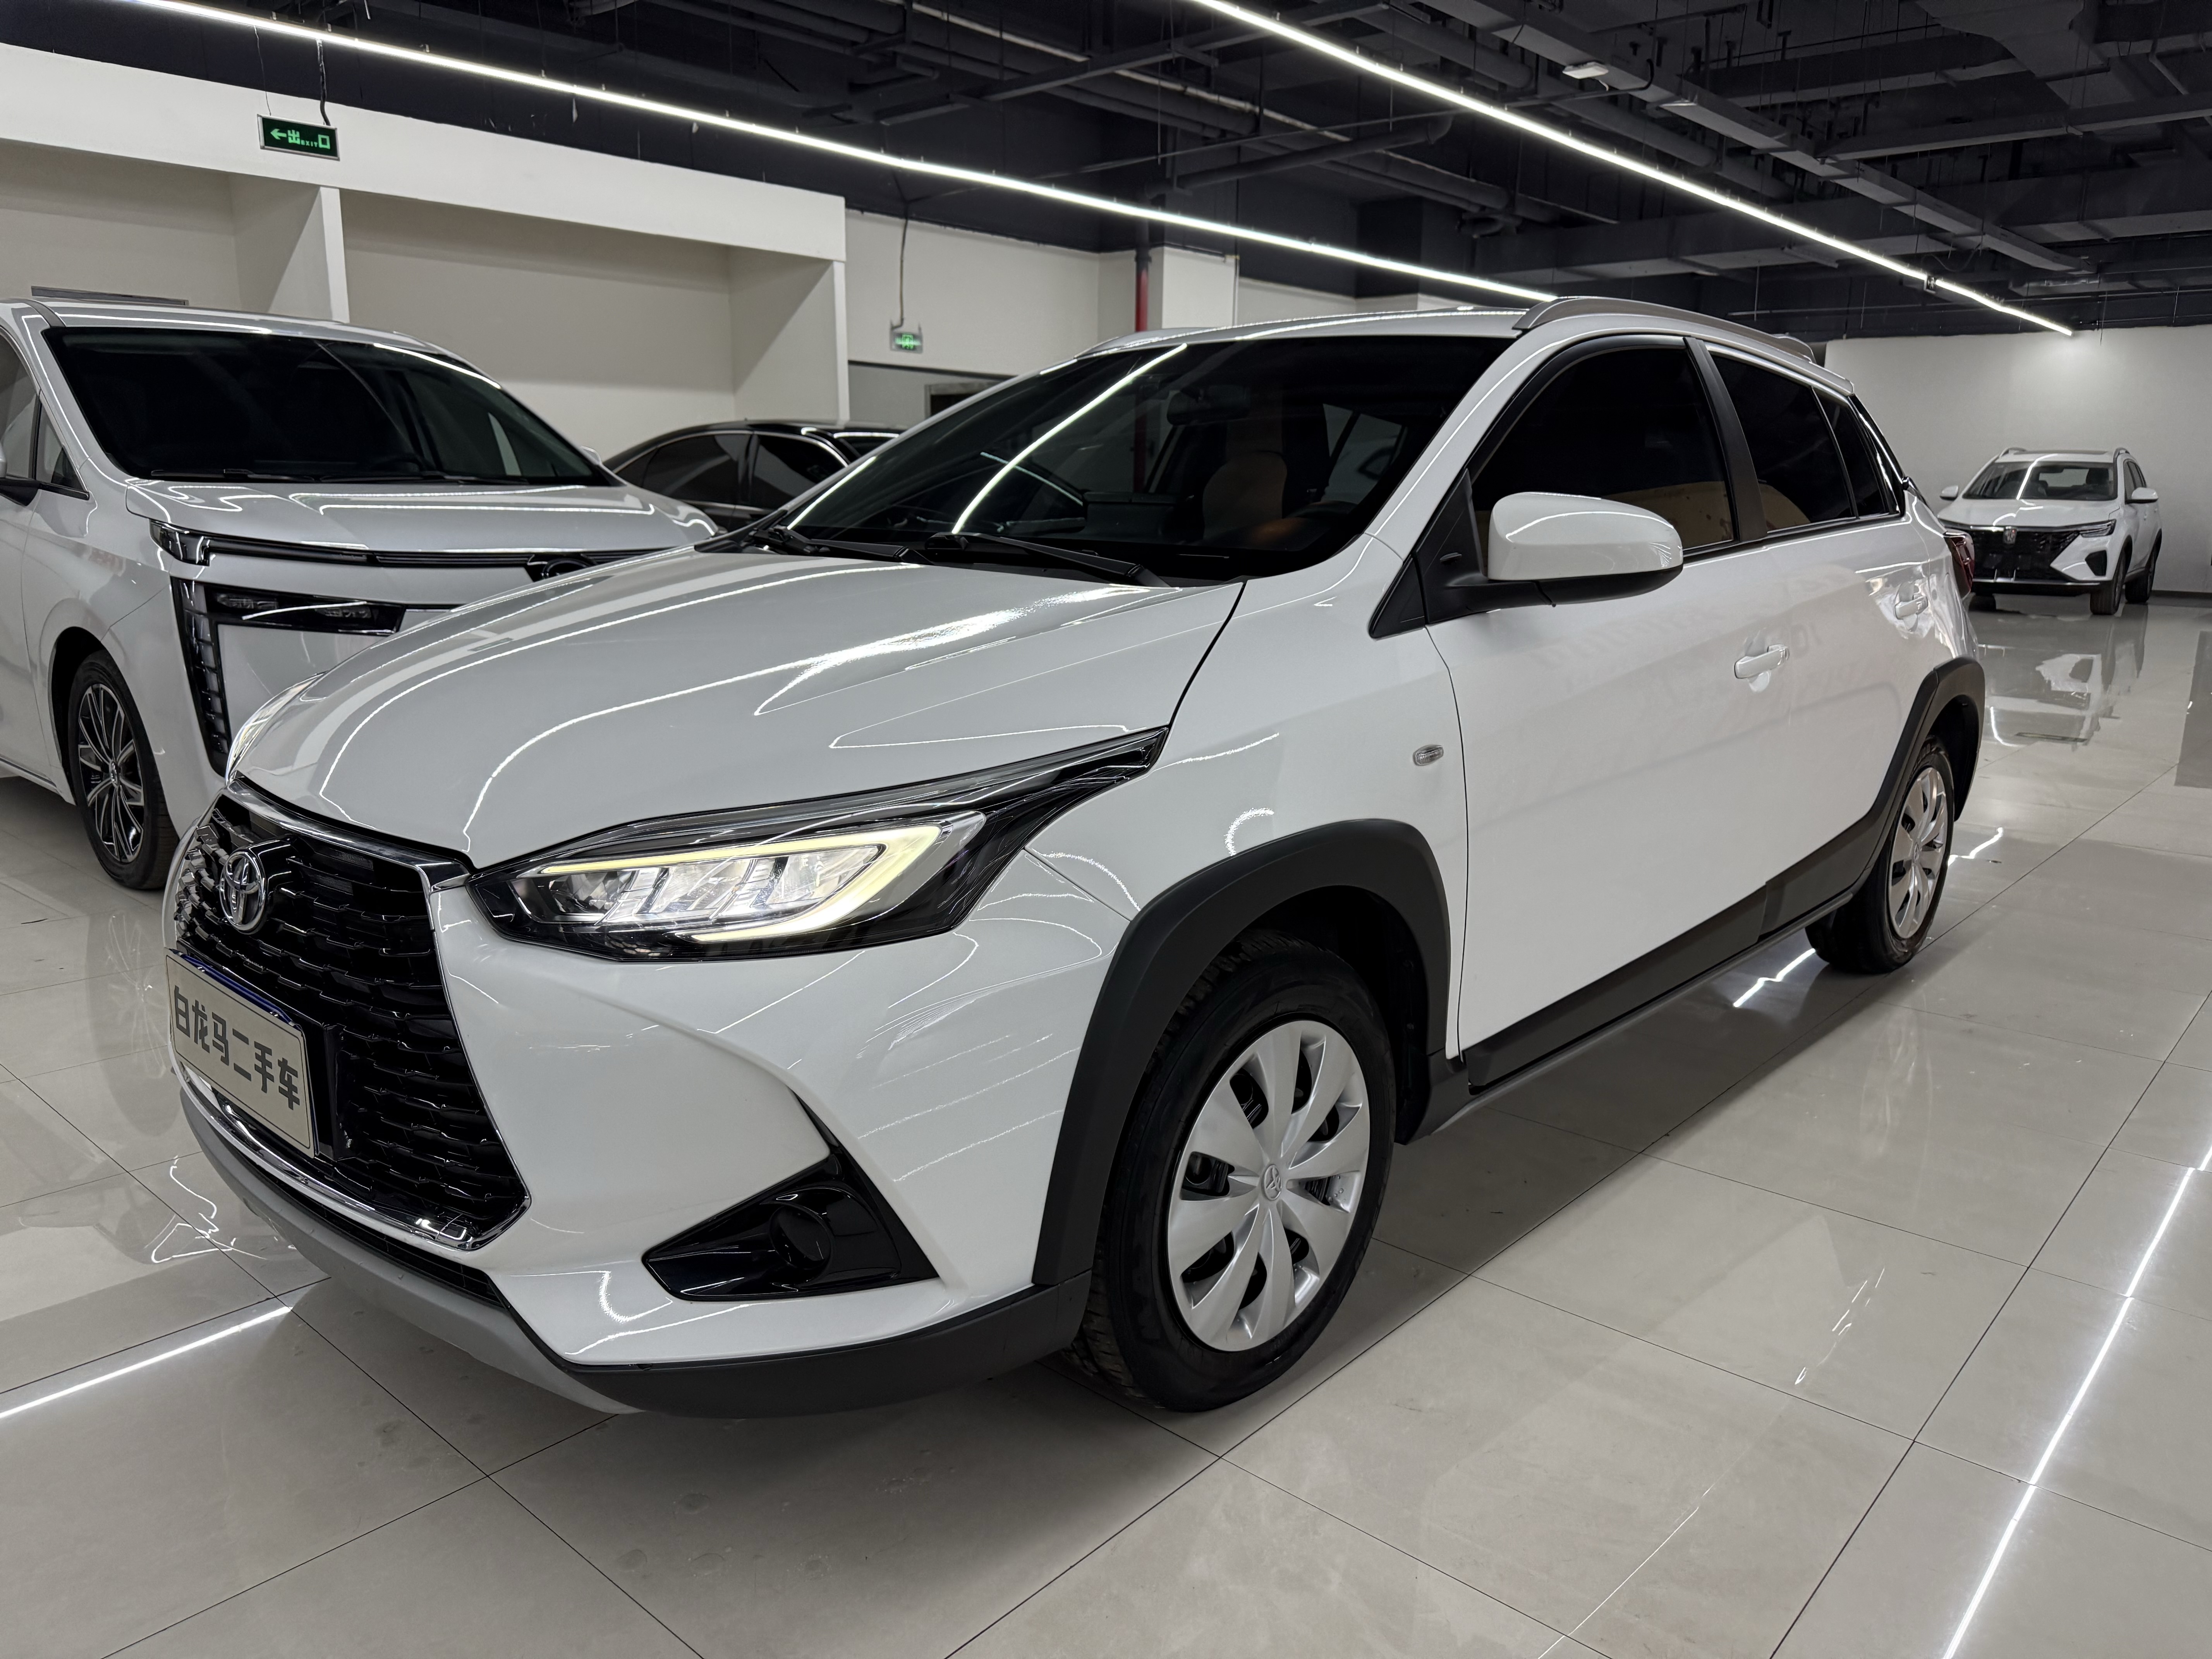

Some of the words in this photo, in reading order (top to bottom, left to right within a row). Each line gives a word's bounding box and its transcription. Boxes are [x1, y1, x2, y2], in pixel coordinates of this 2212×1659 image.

[174, 985, 300, 1110] 白龙马二手车
